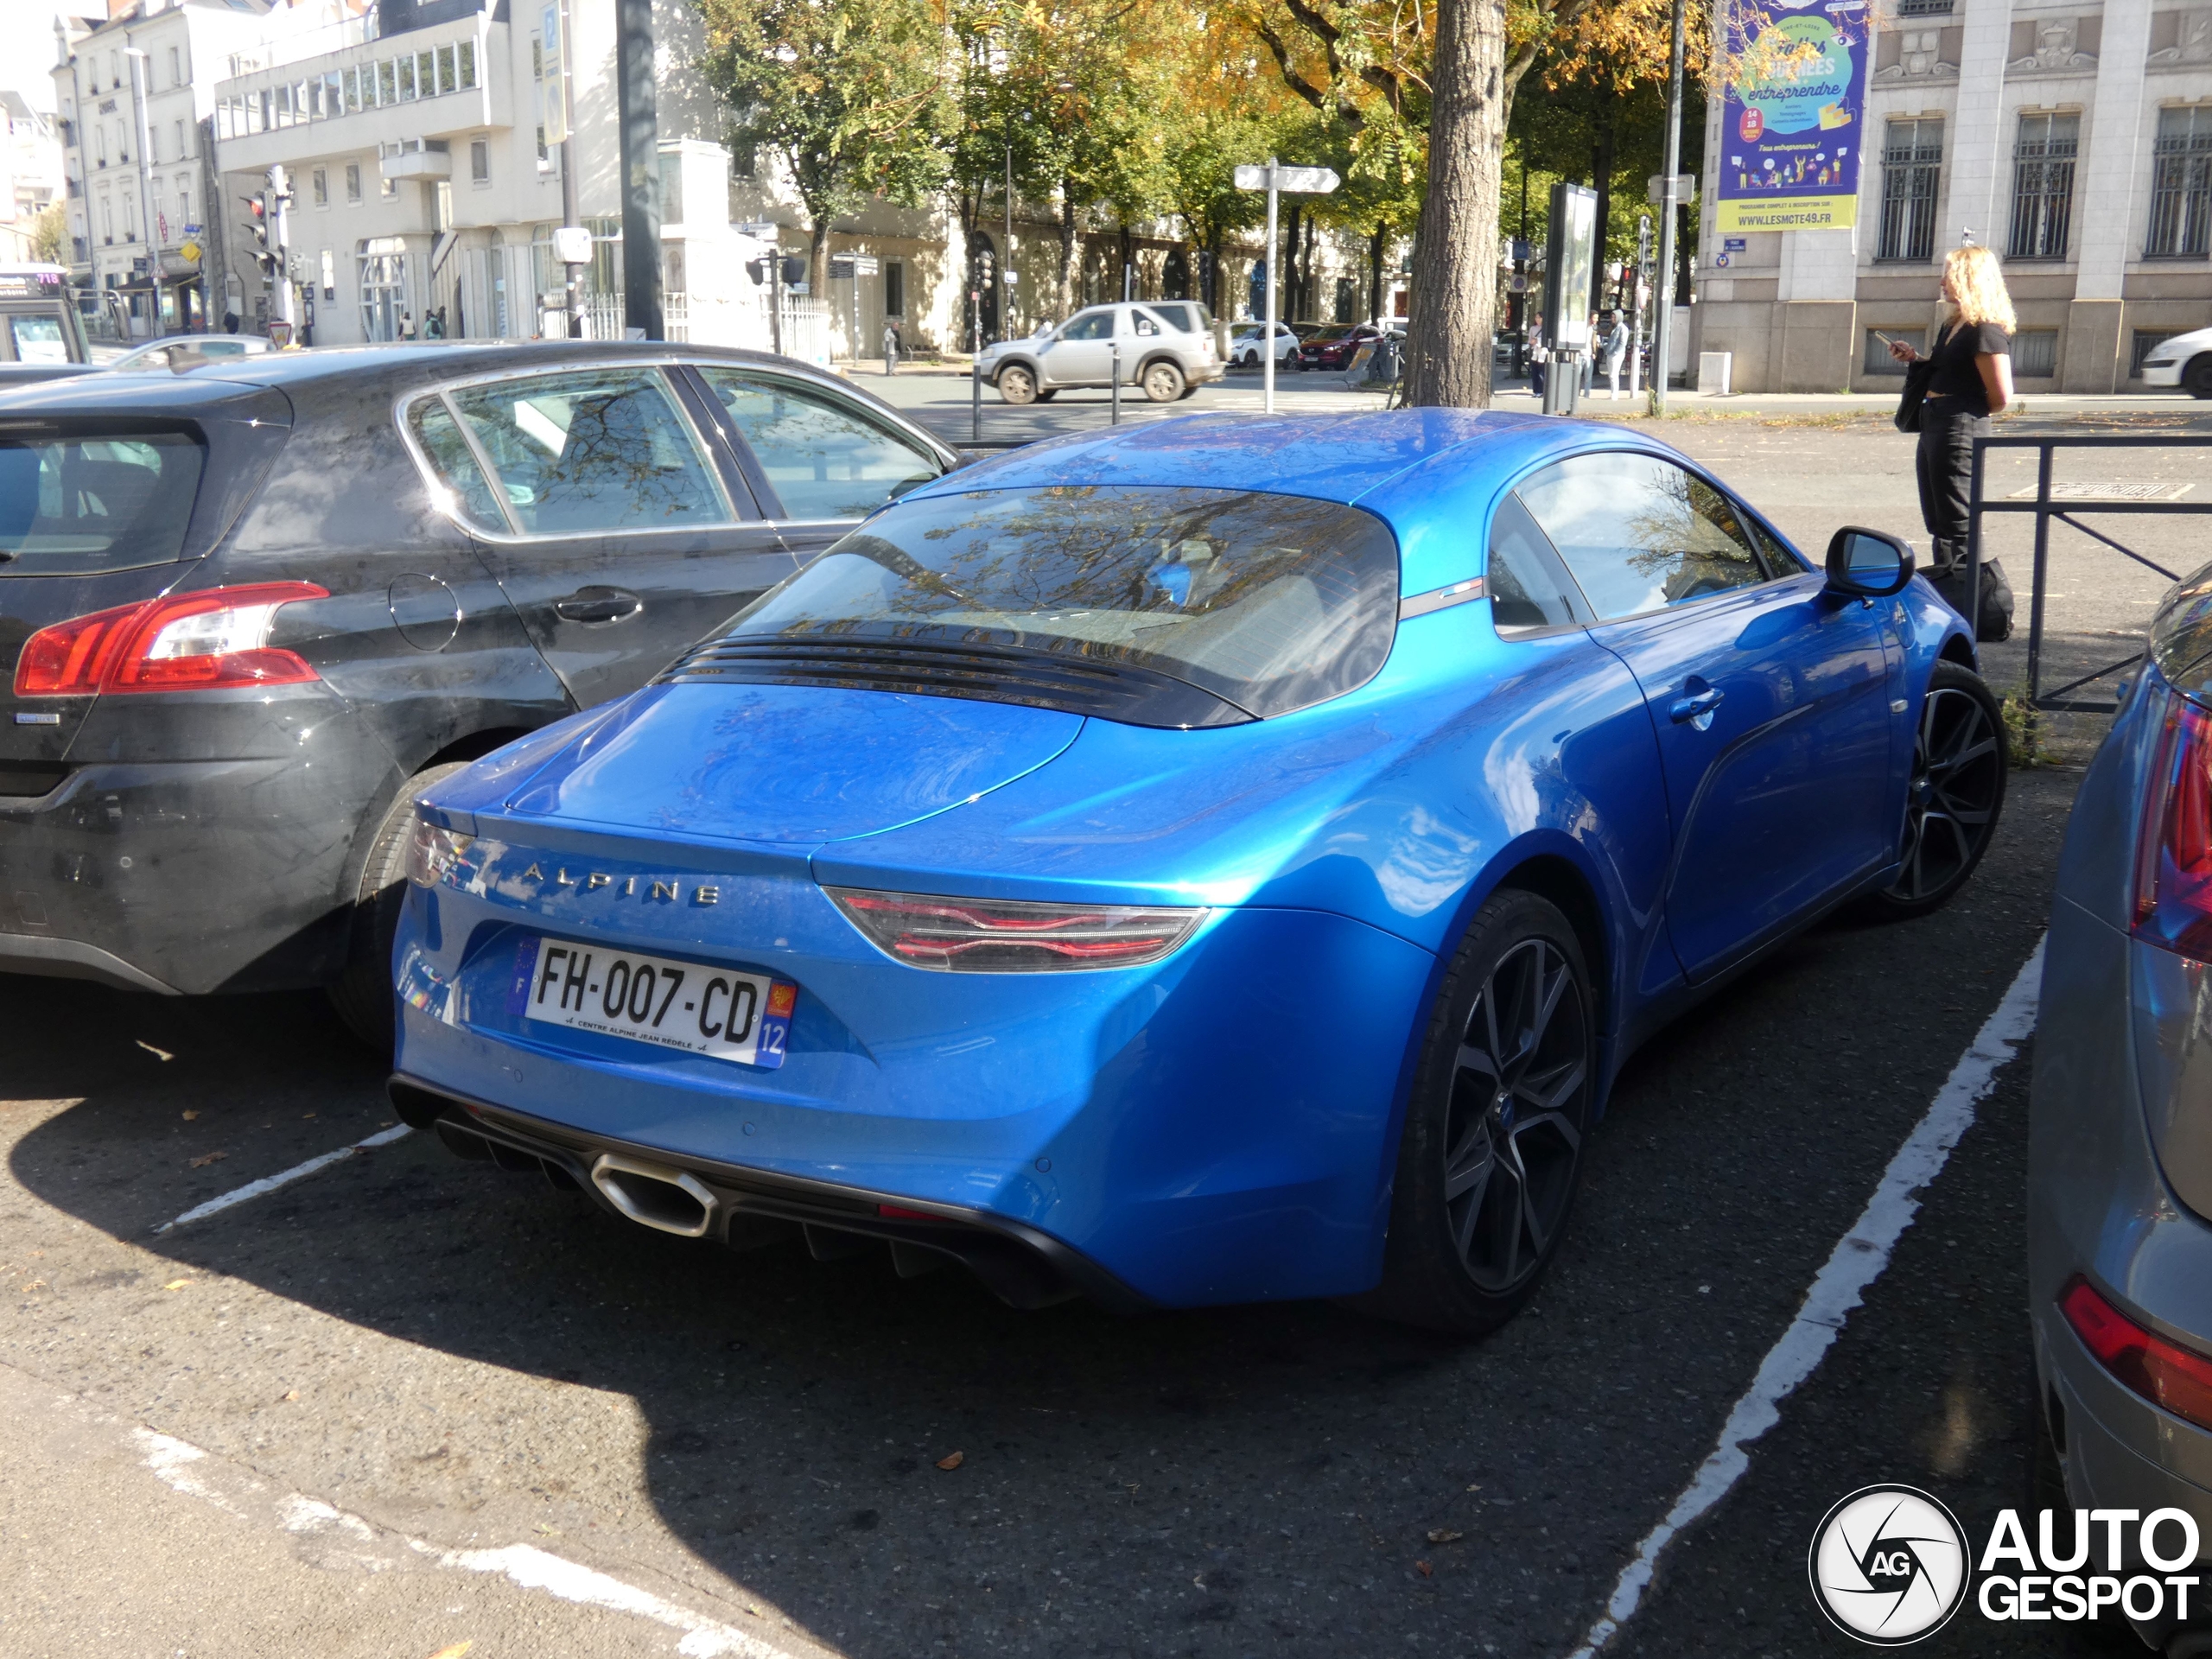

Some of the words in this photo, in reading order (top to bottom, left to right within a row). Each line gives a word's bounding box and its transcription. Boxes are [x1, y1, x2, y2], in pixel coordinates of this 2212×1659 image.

[1748, 81, 1841, 103] entreprendre
[1747, 110, 1758, 118] 14
[1738, 213, 1831, 226] WWW.LESMCTE49.FR
[37, 273, 59, 284] 718
[524, 861, 719, 905] ALPINE
[516, 977, 524, 994] F
[537, 946, 757, 1045] FH-007-CD
[578, 1020, 607, 1031] CENTRE
[608, 1027, 638, 1038] ALPINE
[639, 1033, 659, 1042] JEAN
[762, 1023, 785, 1054] 12
